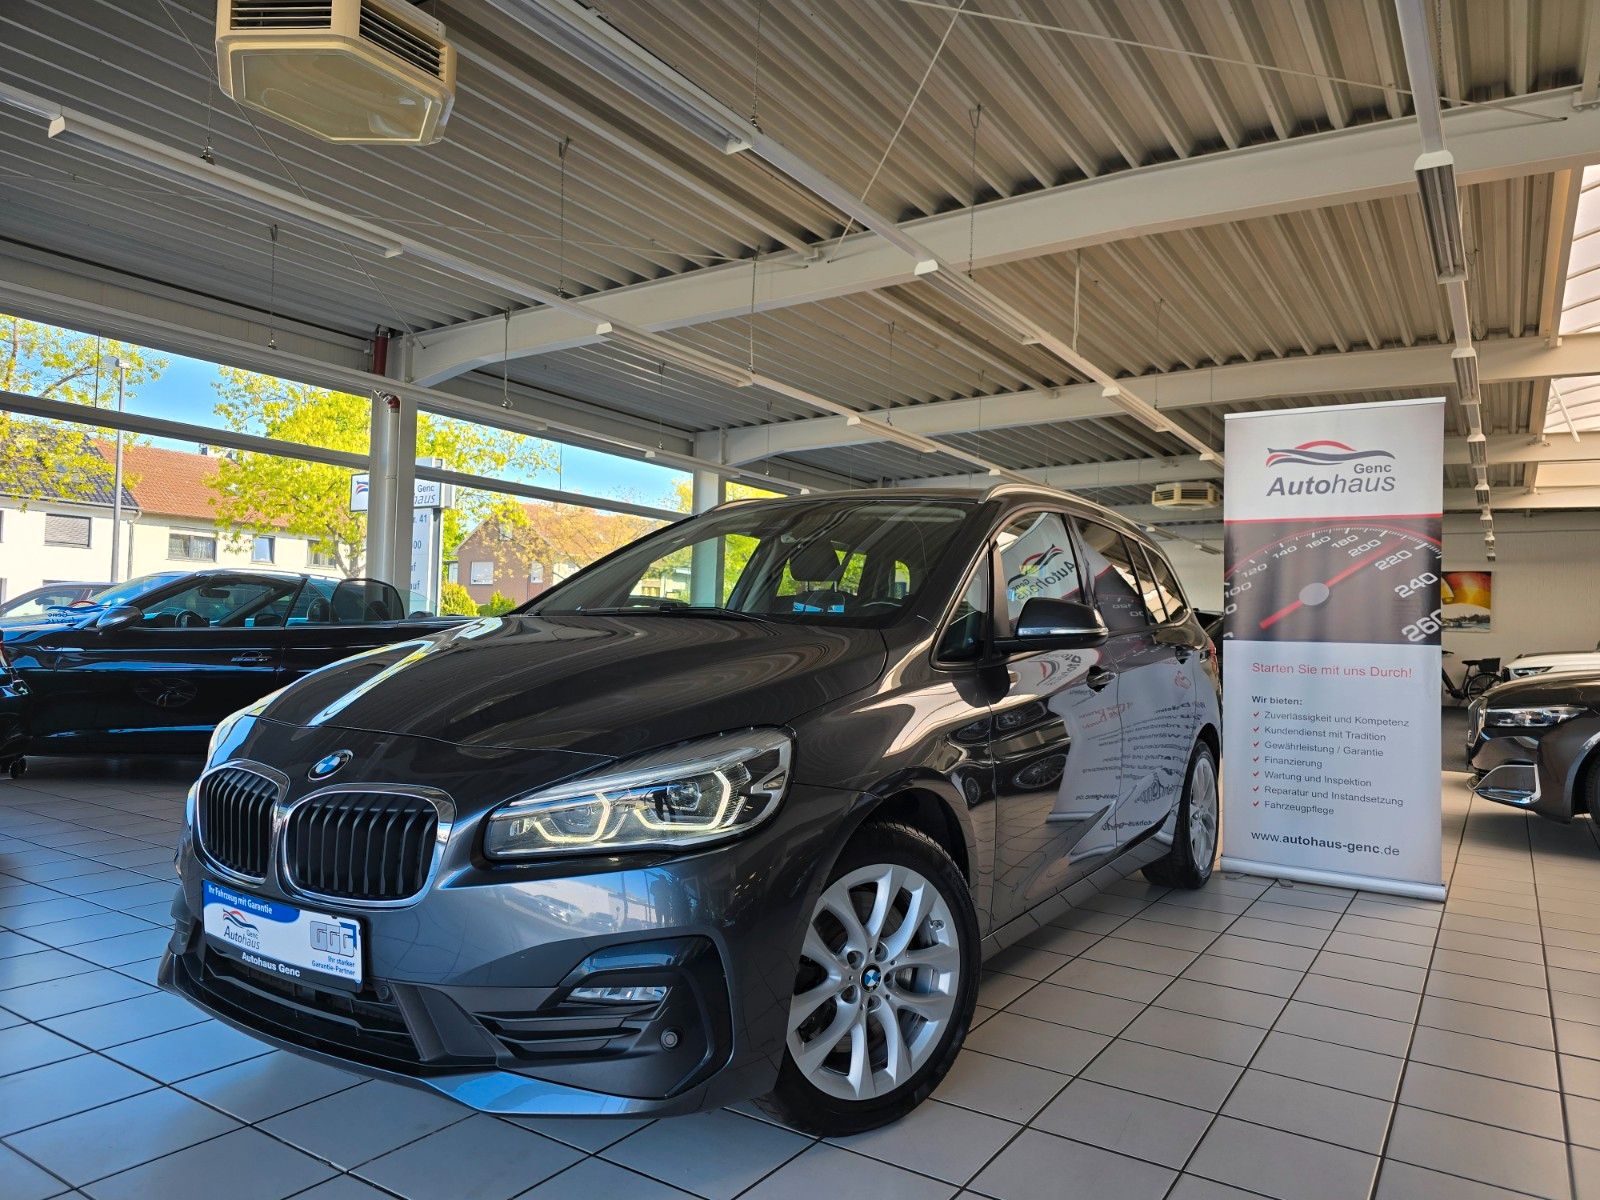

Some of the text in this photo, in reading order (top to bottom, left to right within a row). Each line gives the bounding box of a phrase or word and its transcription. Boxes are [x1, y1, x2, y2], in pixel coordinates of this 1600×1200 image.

[1353, 463, 1392, 474] Genc
[417, 485, 434, 493] Genc
[1266, 474, 1396, 497] Autohaus
[1305, 535, 1331, 549] 160
[1348, 539, 1381, 557] 200
[1272, 545, 1297, 559] 140
[1375, 550, 1412, 571] 220
[1241, 563, 1267, 578] 120
[1224, 582, 1251, 599] 100
[1395, 572, 1438, 598] 240
[1252, 662, 1412, 678] Starten Sie mit uns Durch!
[1251, 695, 1303, 706] Wir bieten:
[1264, 711, 1410, 727] Zuverlässigkeit und Kompetenz
[1264, 726, 1386, 741] Kundendienst mit Tradition
[1264, 740, 1335, 755] Gewährleistung
[1343, 746, 1384, 757] Garantie
[1264, 755, 1323, 769] Finanzierung
[1264, 770, 1372, 787] Wartung und Inspektion
[1264, 785, 1404, 808] Reparatur und Instandsetzung
[1264, 800, 1335, 816] Fahrzeugpflege
[1251, 832, 1400, 856] www.autohaus-genc.de
[215, 887, 238, 905] Fahrzeug
[237, 897, 247, 907] mit
[247, 899, 273, 915] Garantie
[223, 925, 261, 950] Autohaus
[241, 952, 301, 978] Autohaus Genc
